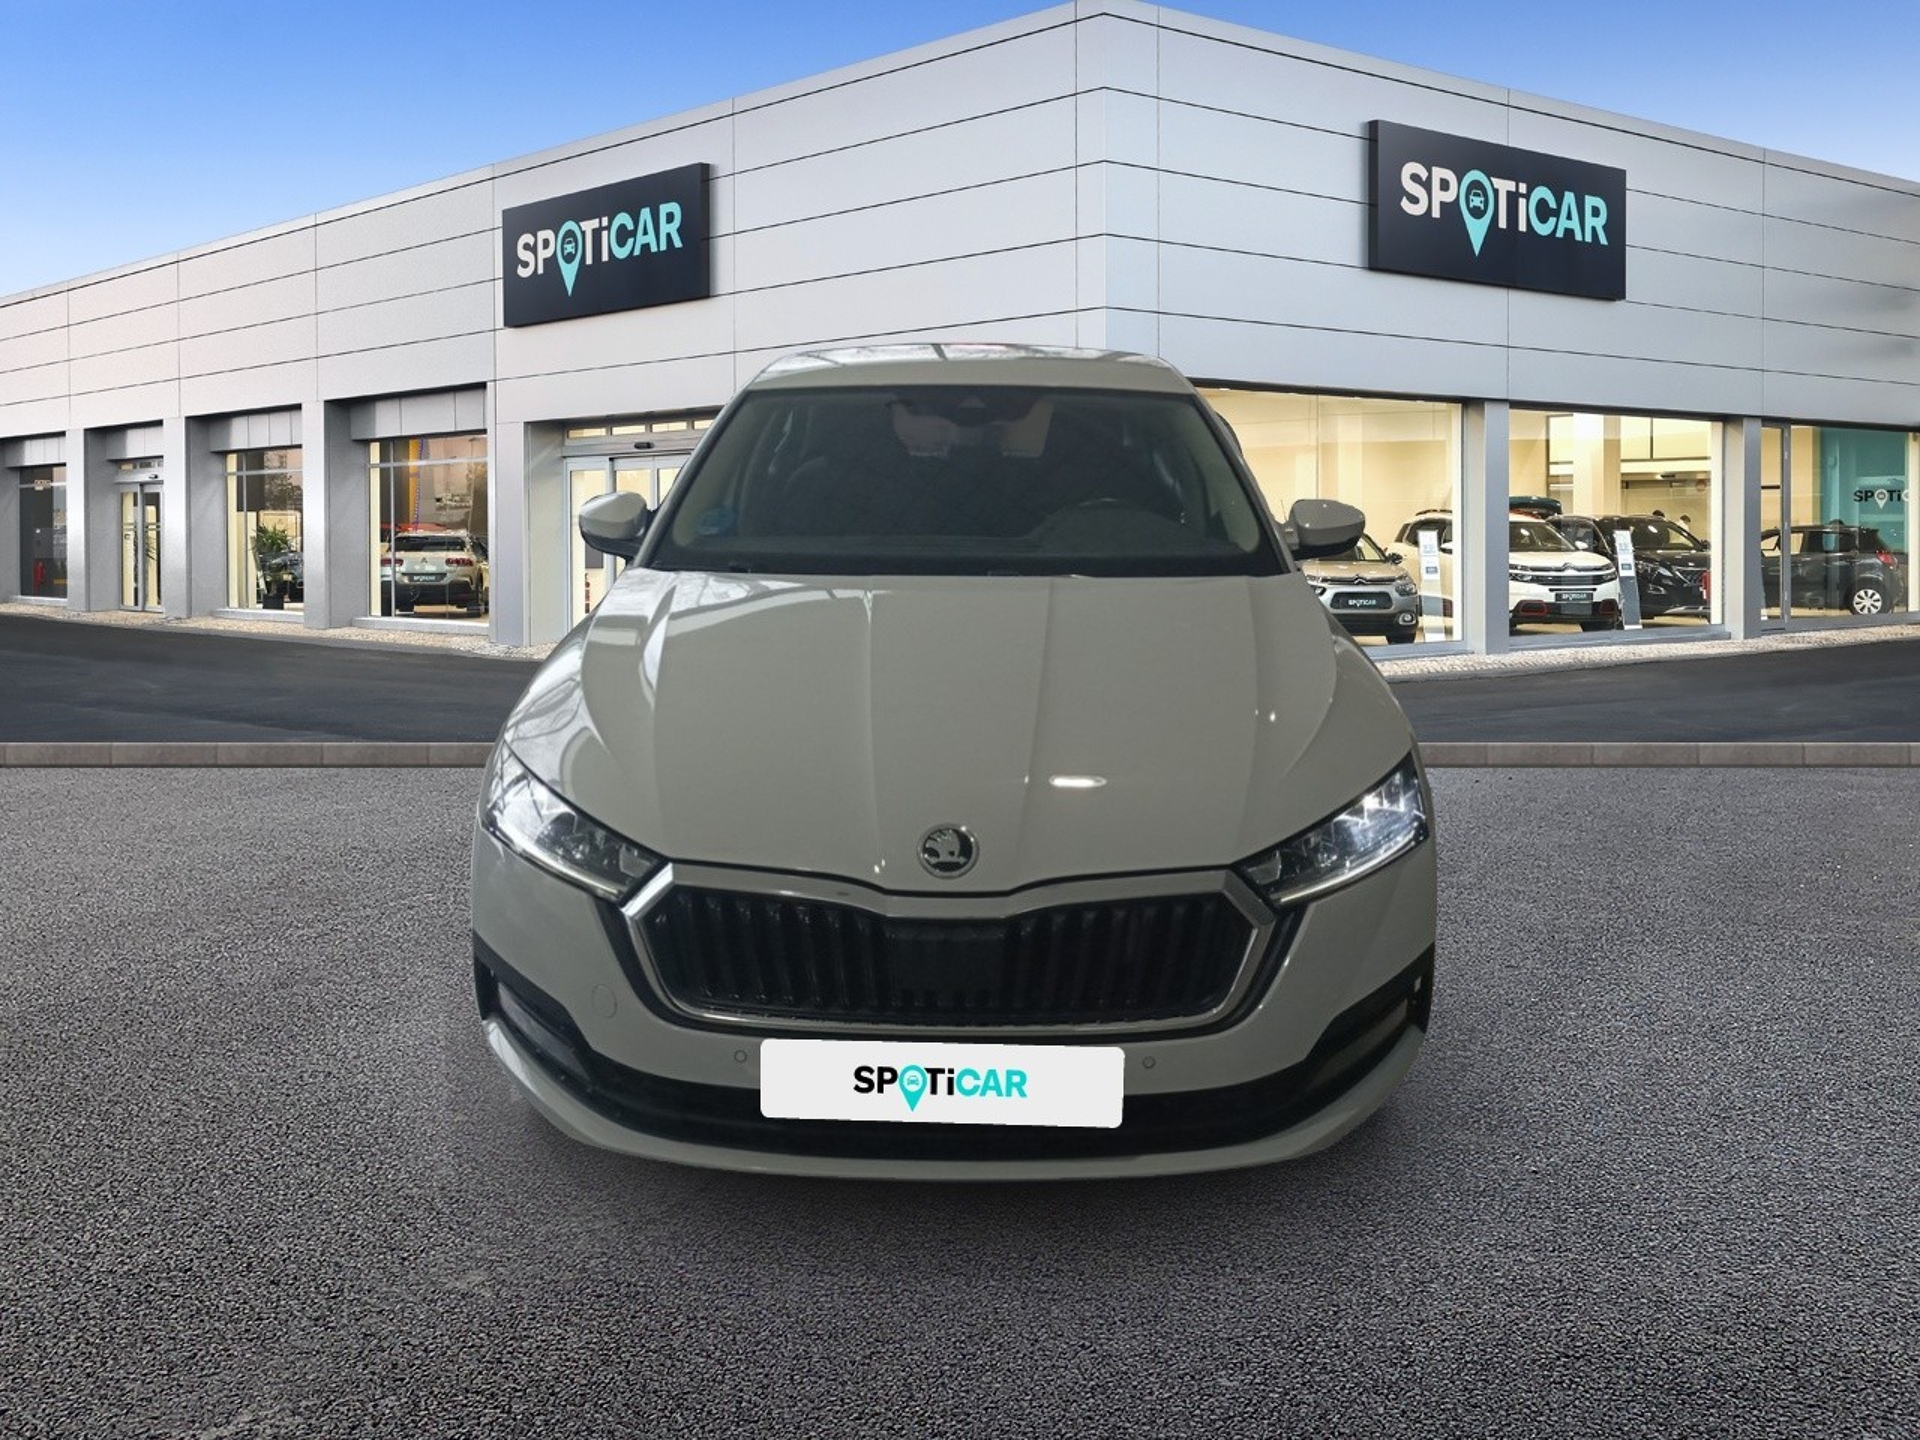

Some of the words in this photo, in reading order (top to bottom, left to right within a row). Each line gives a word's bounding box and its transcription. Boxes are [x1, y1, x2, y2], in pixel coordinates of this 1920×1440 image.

[516, 201, 683, 296] SPOTiCAR
[1400, 161, 1608, 257] SPOTiCAR
[853, 1064, 1028, 1112] SPOTiCAR
